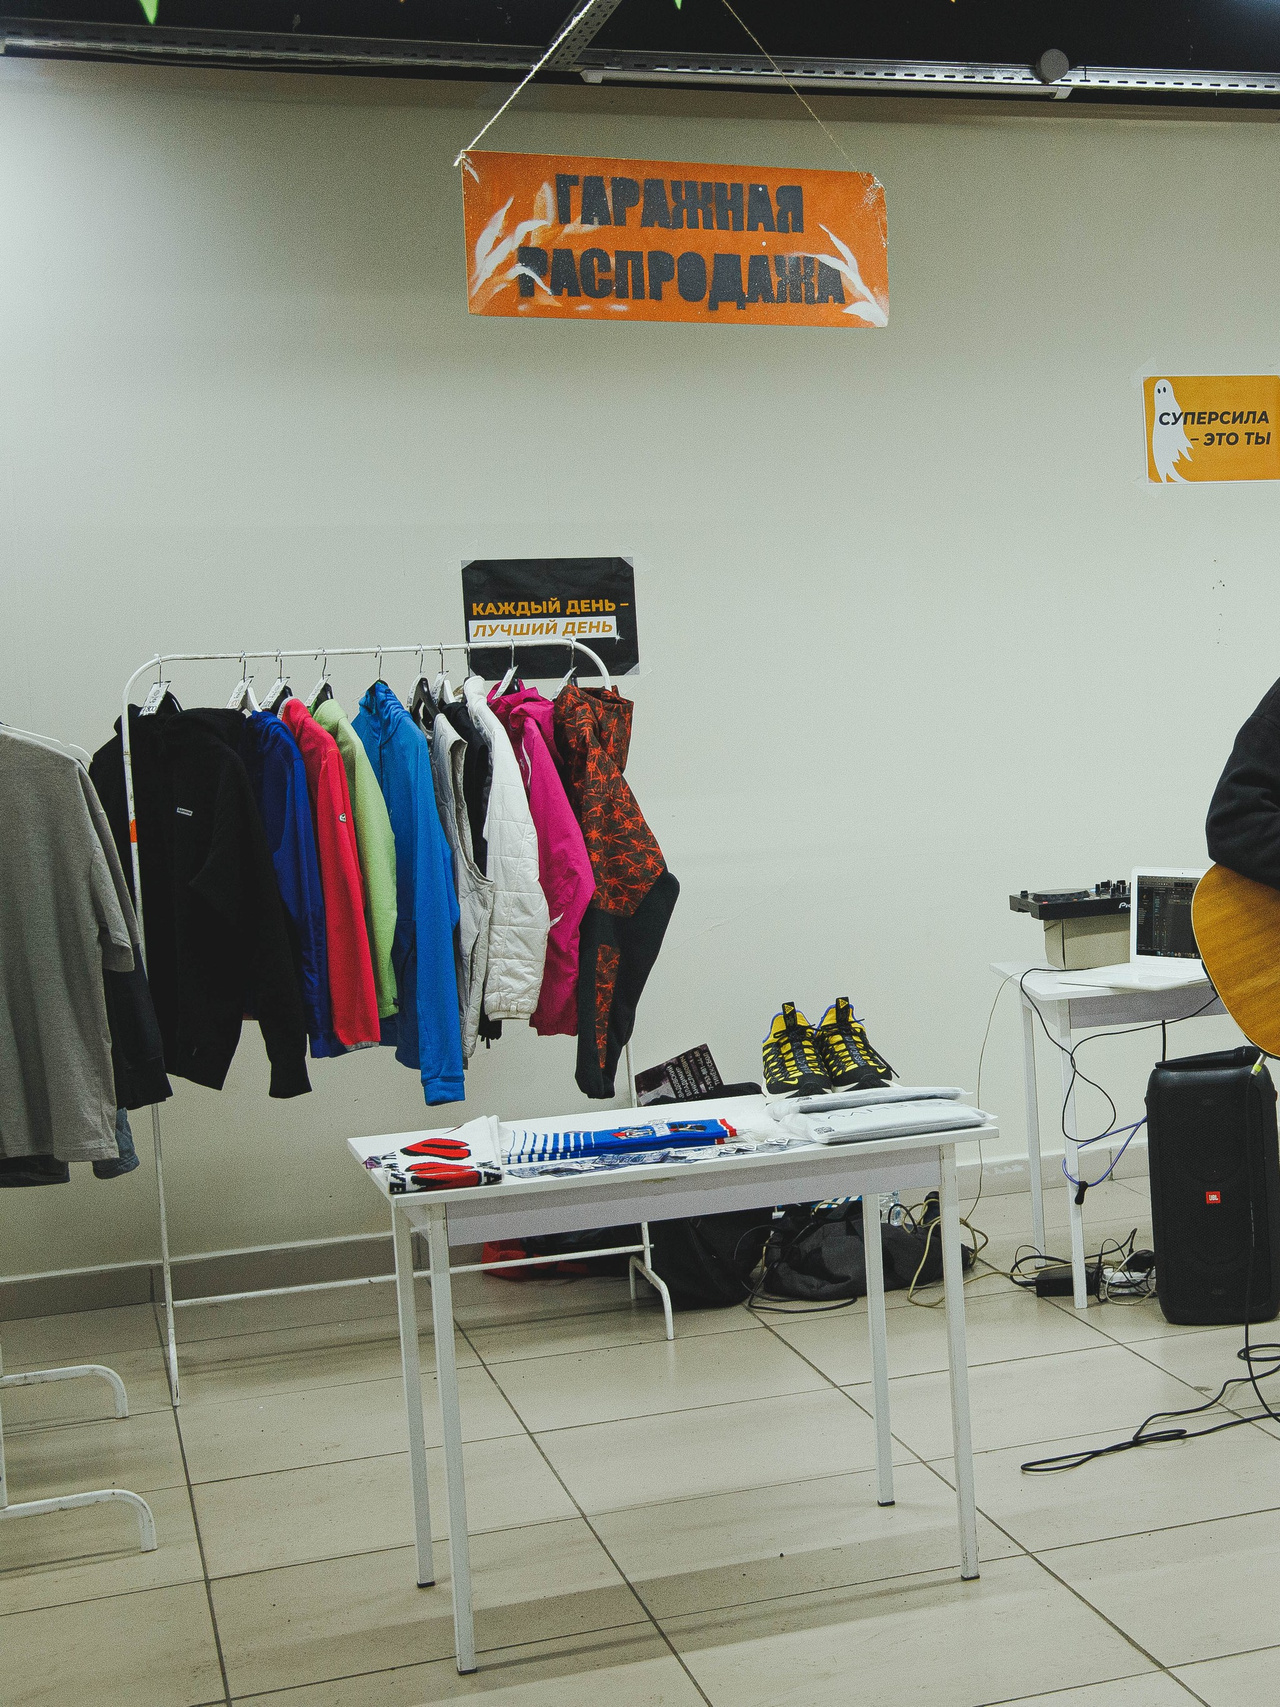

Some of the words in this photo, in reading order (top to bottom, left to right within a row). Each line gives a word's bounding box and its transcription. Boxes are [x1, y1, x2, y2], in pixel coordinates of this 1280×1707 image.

[554, 173, 804, 234] ГАРАЖНАЯ
[518, 246, 846, 311] РАСПРОДАЖА
[1158, 410, 1270, 426] СУПЕРСИЛА
[1203, 432, 1239, 446] ЭТО
[1244, 431, 1271, 446] ТЫ
[472, 597, 561, 616] КАЖДЫЙ
[565, 599, 616, 615] ДЕНЬ
[473, 619, 558, 637] ЛУЧШИЙ
[562, 620, 613, 636] ДЕНЬ
